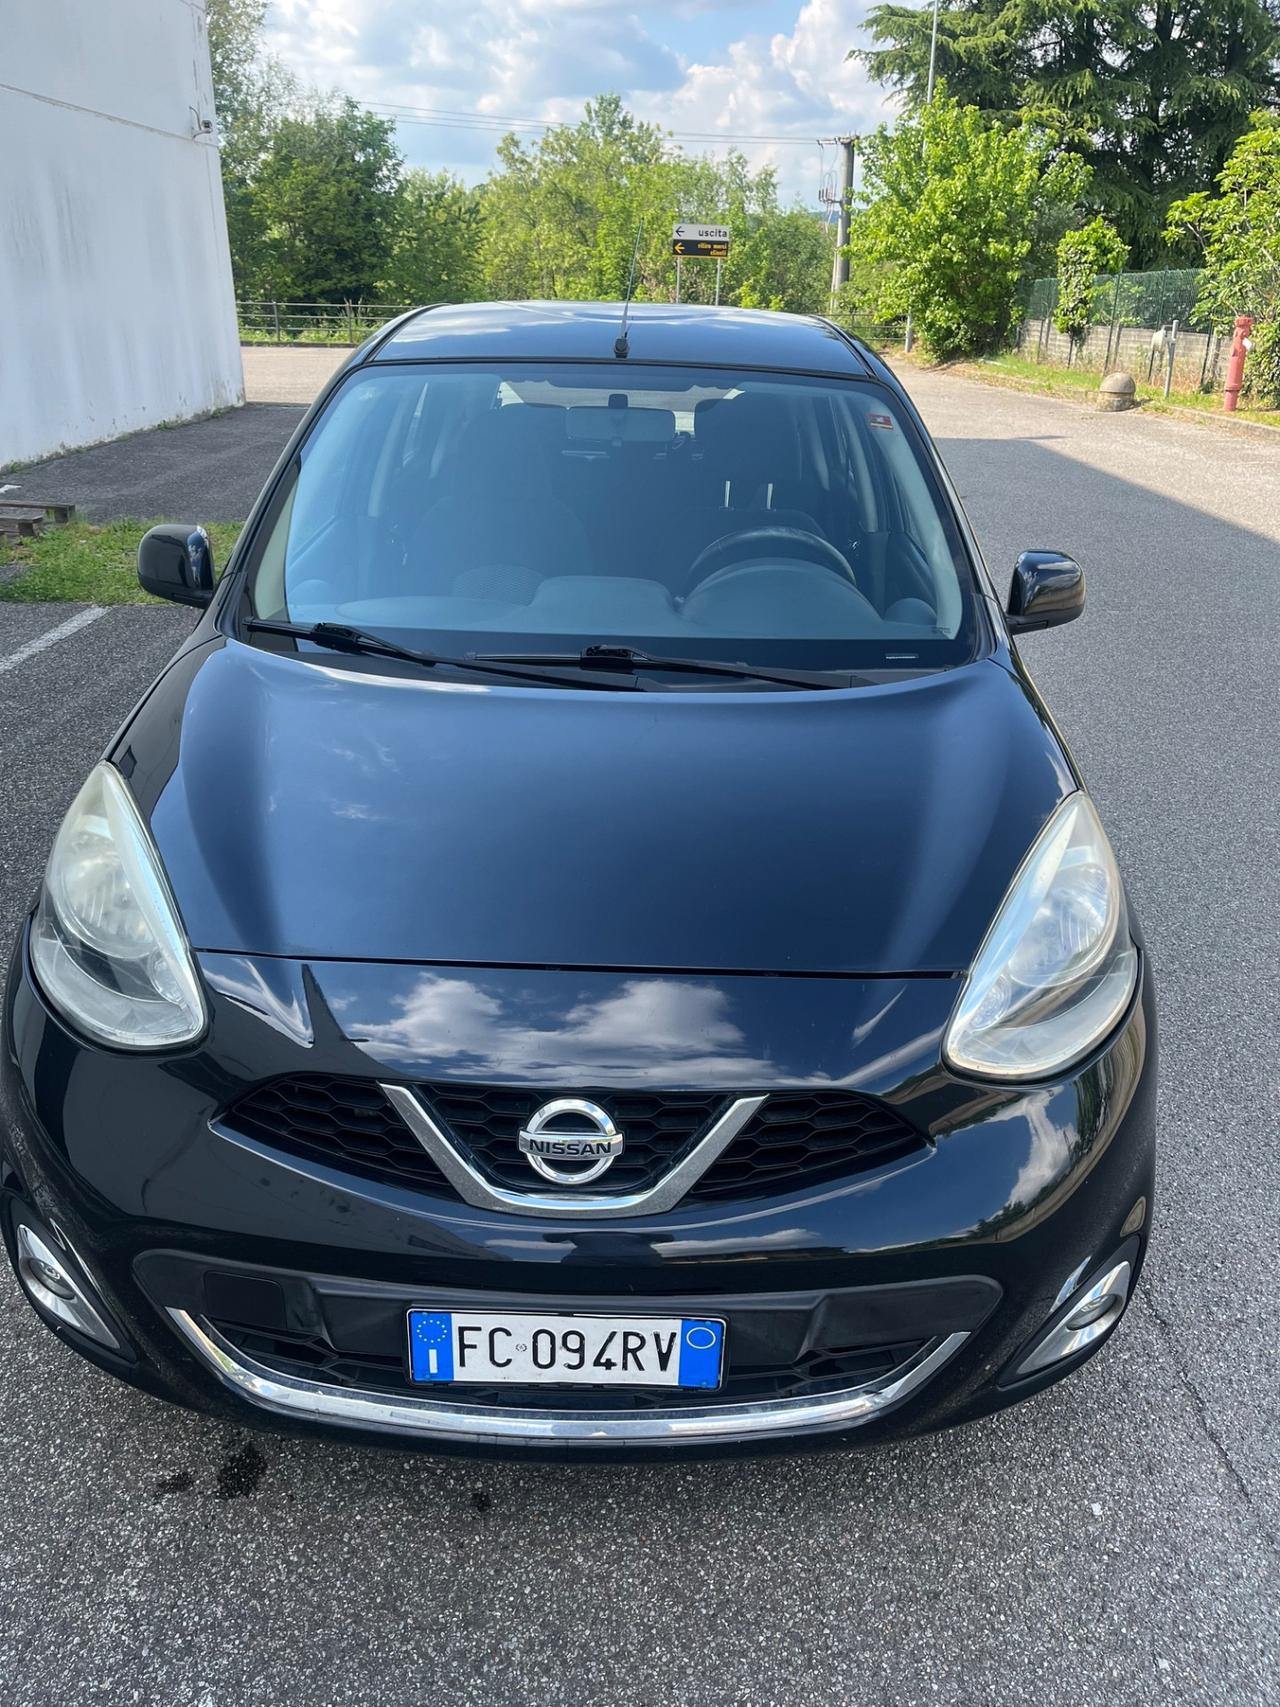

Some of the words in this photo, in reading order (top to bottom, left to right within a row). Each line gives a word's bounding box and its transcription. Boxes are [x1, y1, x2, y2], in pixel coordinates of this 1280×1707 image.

[698, 229, 727, 237] uscita
[529, 1138, 612, 1156] NISSAN
[457, 1325, 513, 1369] FC
[531, 1328, 678, 1372] 094RV
[428, 1348, 439, 1374] I
